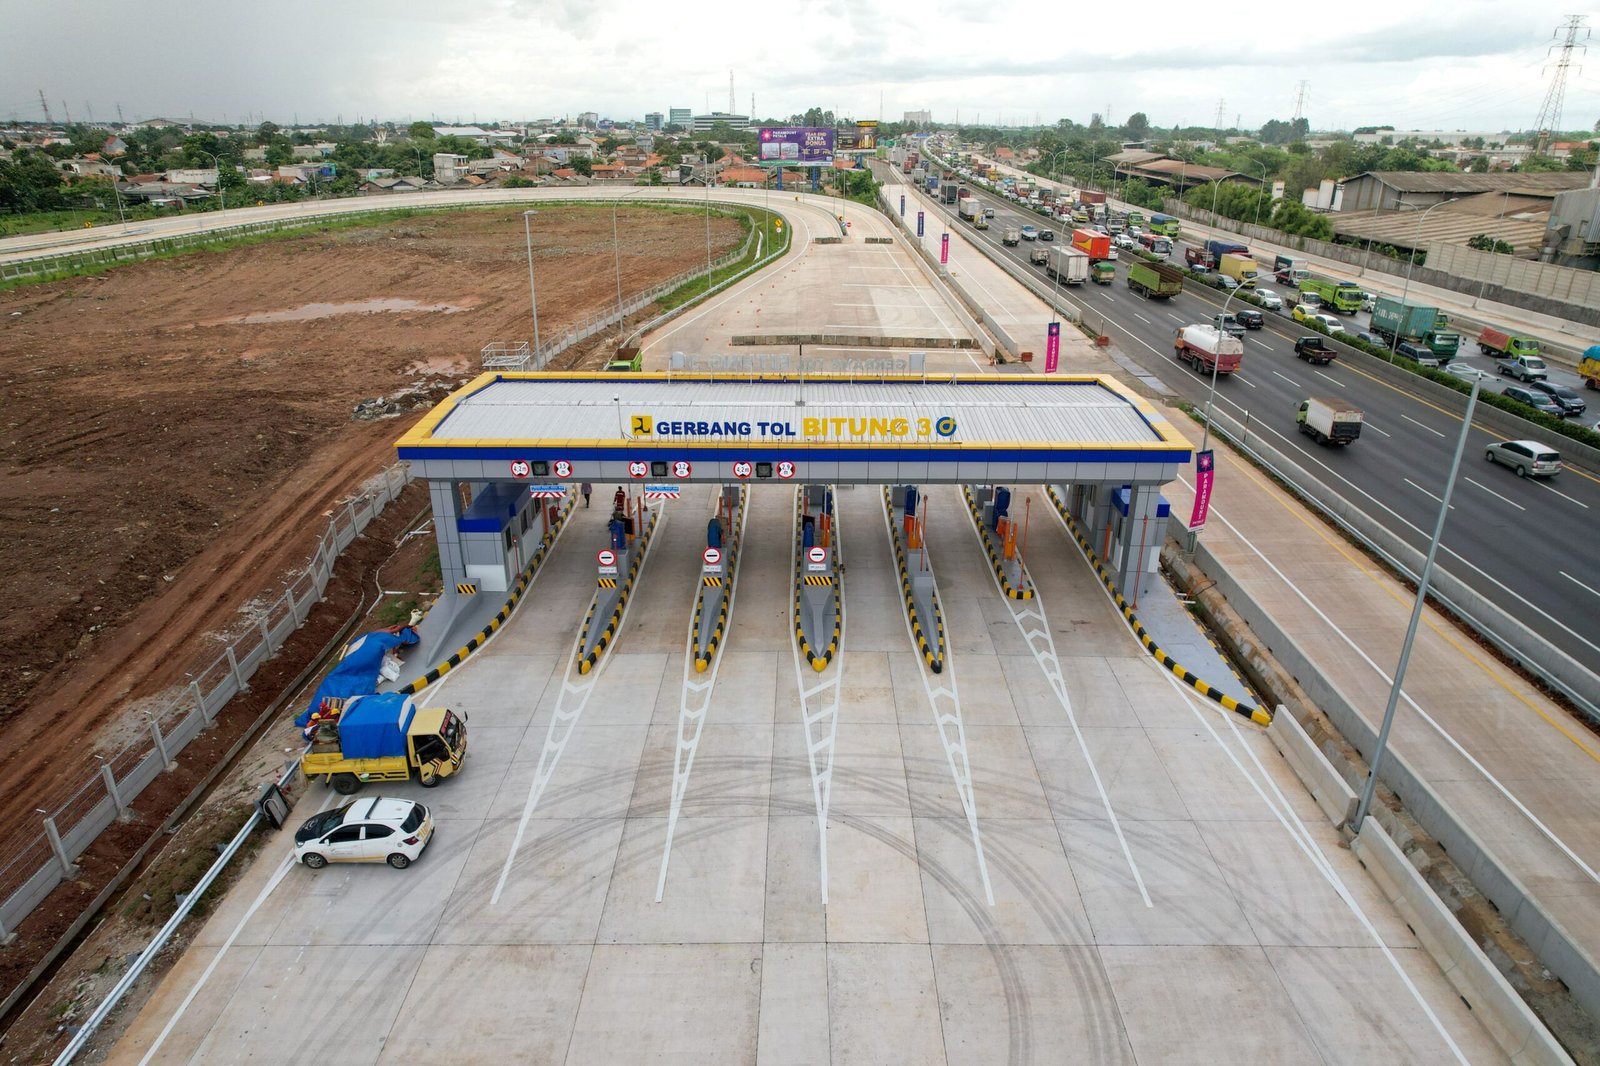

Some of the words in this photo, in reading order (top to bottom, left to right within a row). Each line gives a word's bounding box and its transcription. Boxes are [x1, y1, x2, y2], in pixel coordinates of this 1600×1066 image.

[656, 421, 751, 436] GERBANG
[757, 421, 796, 436] TOL
[803, 418, 909, 436] BITUNG
[916, 418, 932, 436] 3
[1198, 473, 1208, 520] PARAMOUNT
